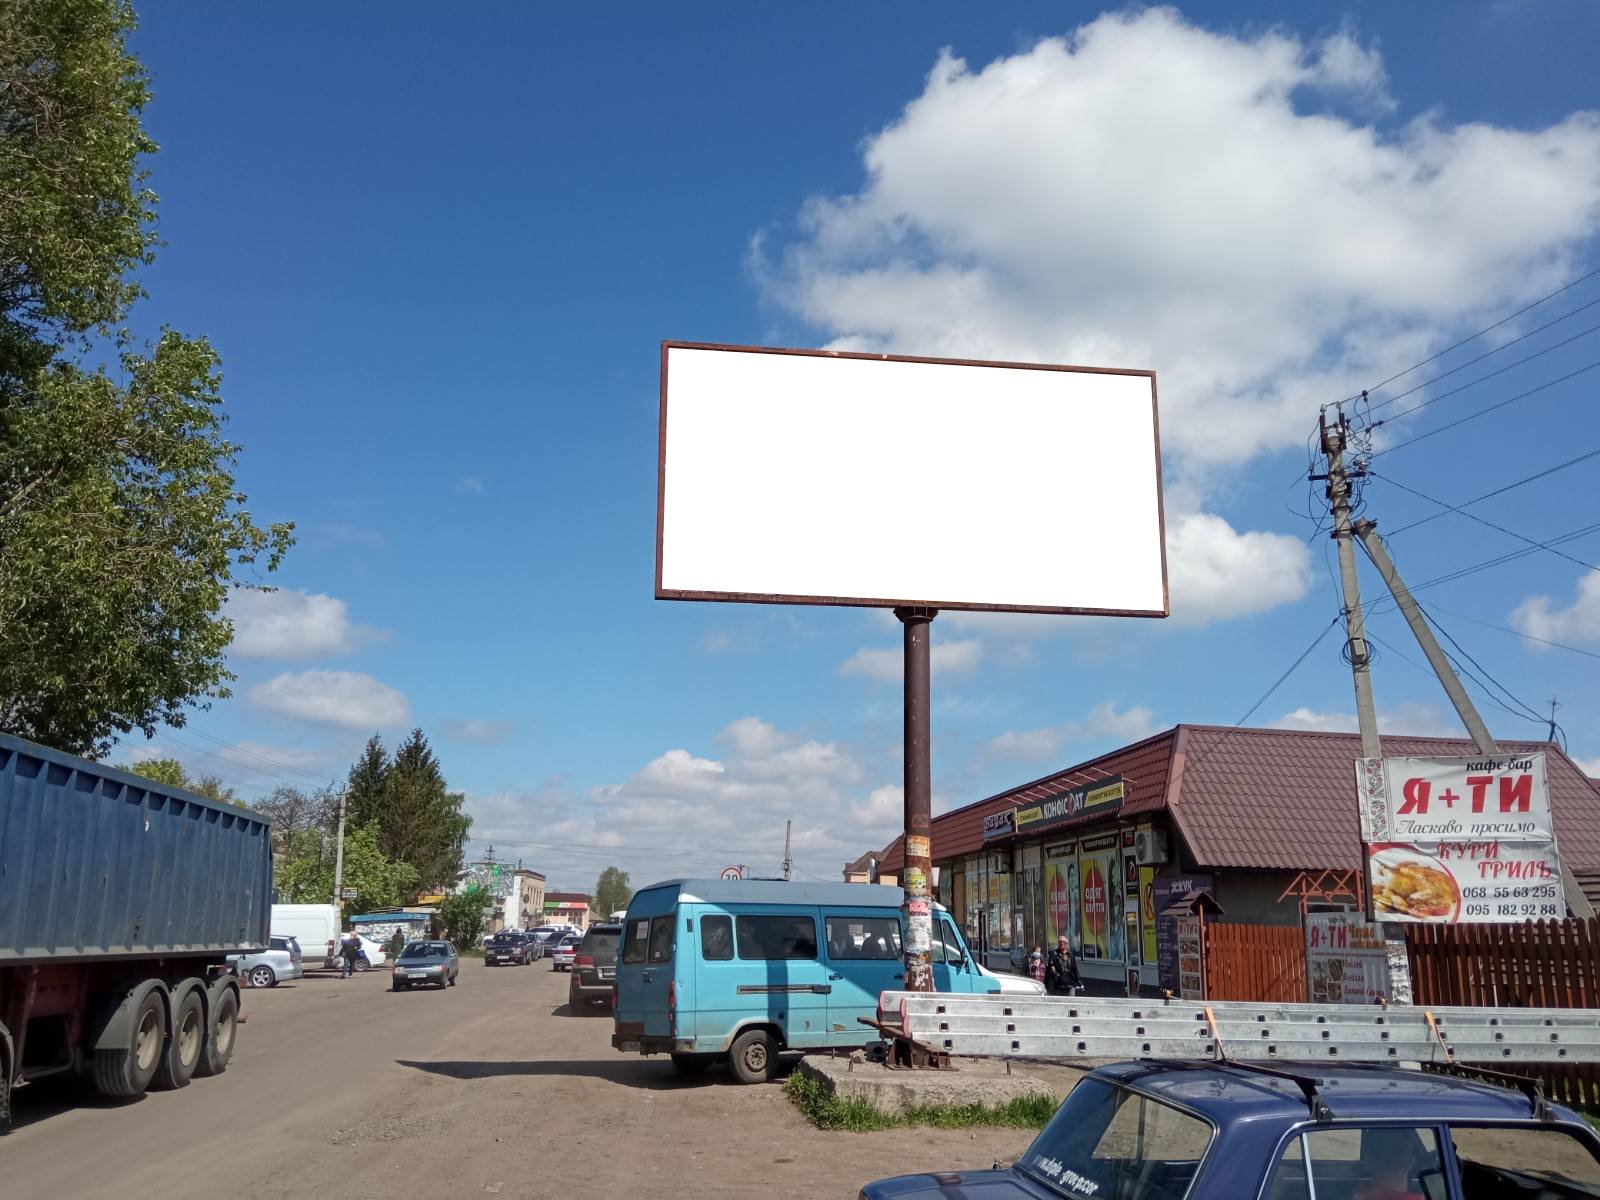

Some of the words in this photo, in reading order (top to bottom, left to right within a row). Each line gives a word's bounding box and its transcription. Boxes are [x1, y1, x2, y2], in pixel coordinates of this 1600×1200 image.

[1466, 758, 1532, 774] кафе-бар
[1395, 819, 1463, 834] Ласкаво
[1470, 821, 1536, 836] просимо
[1462, 886, 1487, 898] 068
[1493, 886, 1510, 898] 55
[1532, 885, 1556, 898] 295
[1466, 904, 1490, 916] 095
[1497, 904, 1518, 916] 182
[1521, 904, 1537, 916] 92
[1540, 904, 1556, 916] 88
